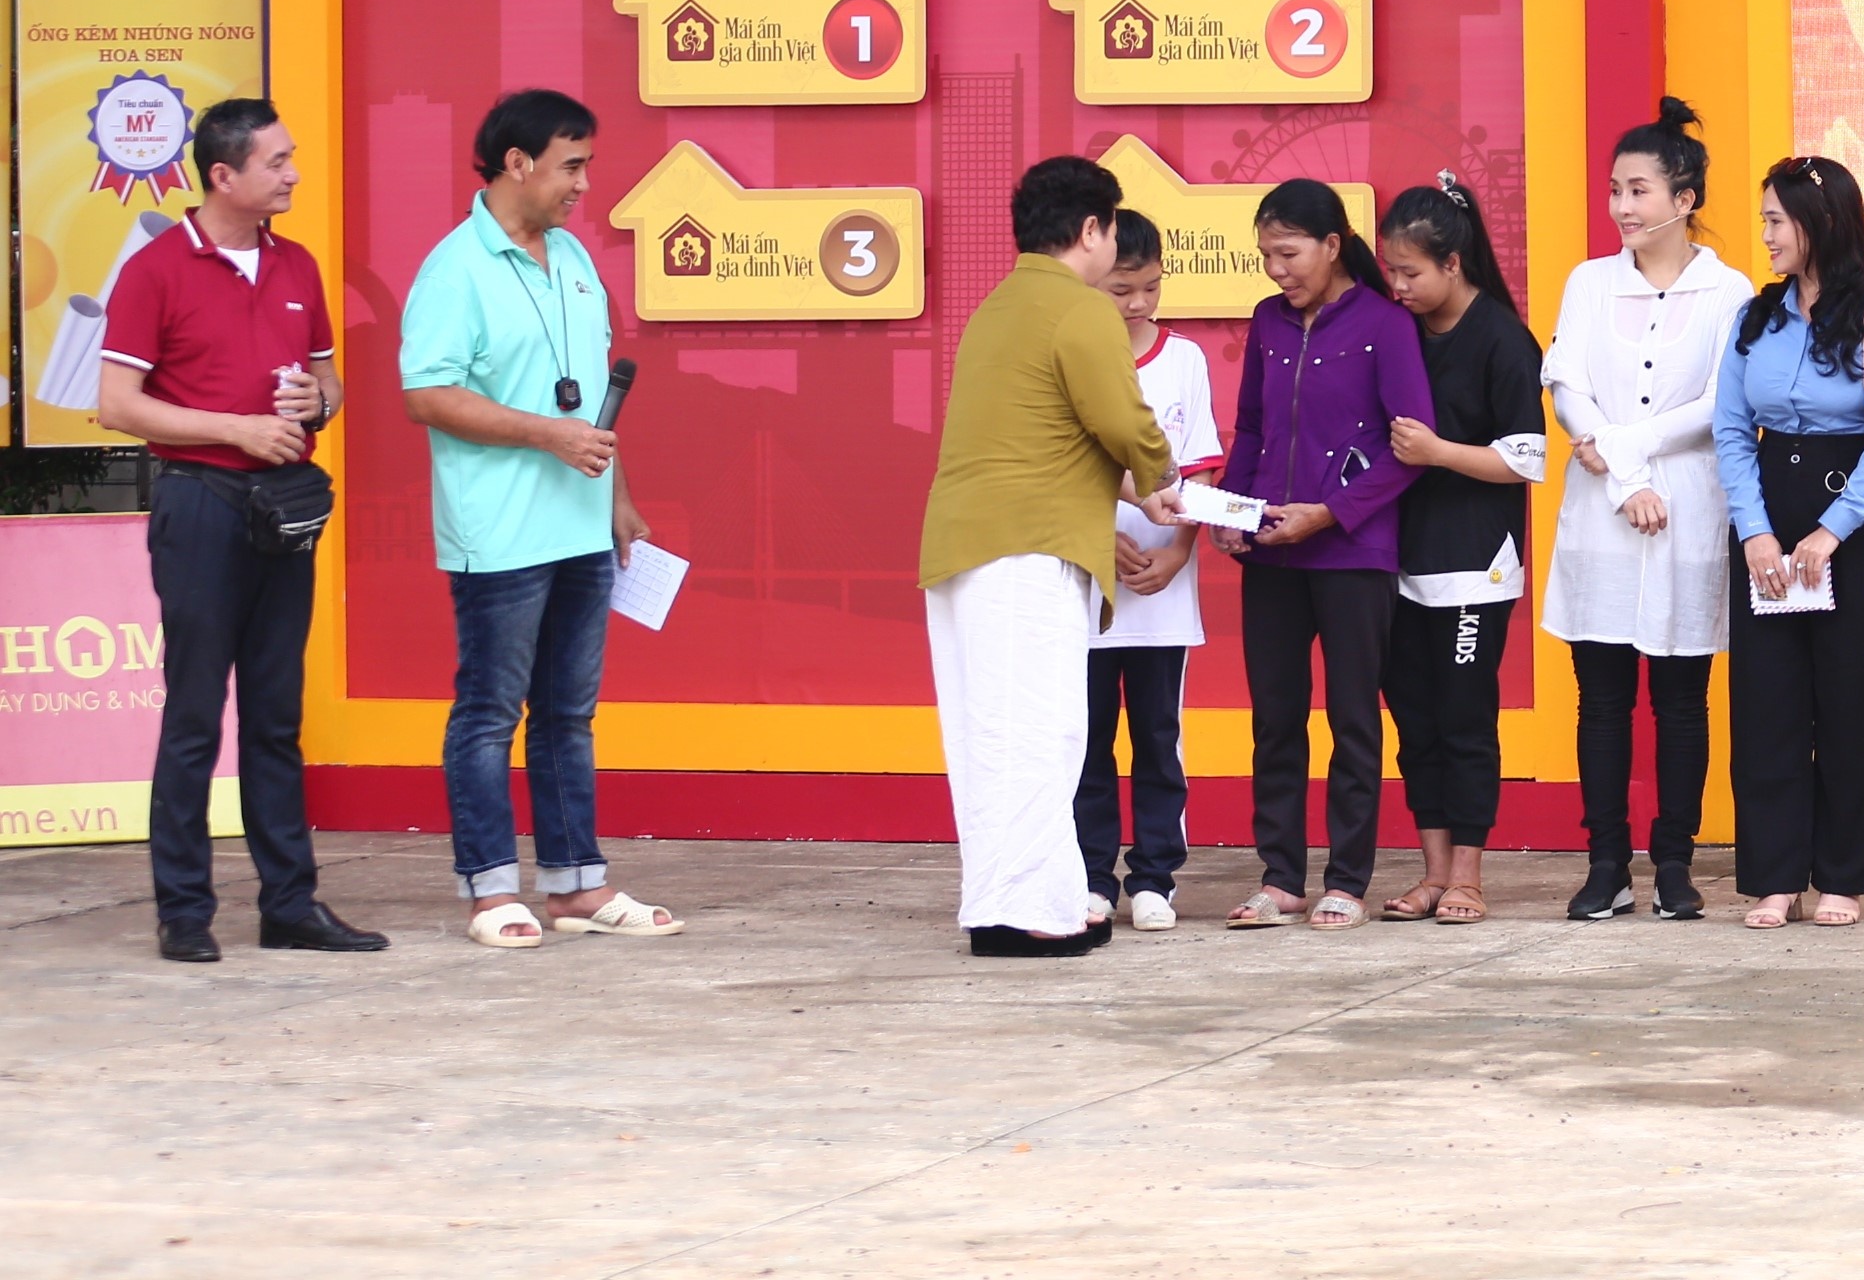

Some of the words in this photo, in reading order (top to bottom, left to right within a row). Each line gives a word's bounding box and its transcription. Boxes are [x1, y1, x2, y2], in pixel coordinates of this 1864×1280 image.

[27, 23, 69, 42] ỐNG
[74, 24, 118, 41] KẼM
[123, 23, 194, 41] NHÚNG
[198, 22, 256, 40] NÓNG
[725, 17, 755, 40] Mái
[758, 16, 782, 39] ấm
[849, 15, 872, 62] 1
[1164, 14, 1193, 38] Mái
[1198, 12, 1224, 37] ấm
[1288, 7, 1326, 56] 2
[99, 48, 140, 62] HOA
[145, 48, 184, 62] SEN
[719, 42, 743, 67] gia
[746, 39, 783, 61] đình
[786, 39, 817, 65] Việt
[1158, 40, 1182, 65] gia
[1187, 37, 1225, 60] đình
[1227, 37, 1260, 64] Việt
[126, 110, 156, 133] MỸ
[721, 232, 750, 254] Mái
[754, 230, 779, 253] ấm
[842, 229, 878, 277] 3
[1166, 228, 1195, 251] Mái
[1199, 227, 1225, 251] ấm
[716, 257, 739, 282] gia
[743, 253, 780, 277] đình
[783, 253, 815, 280] Việt
[1160, 254, 1184, 280] gia
[1189, 251, 1227, 274] đình
[1229, 251, 1263, 277] Việt
[0, 615, 164, 679] HOM
[32, 690, 101, 716] DỰNG
[107, 689, 123, 710] &
[129, 683, 167, 713] NỘ
